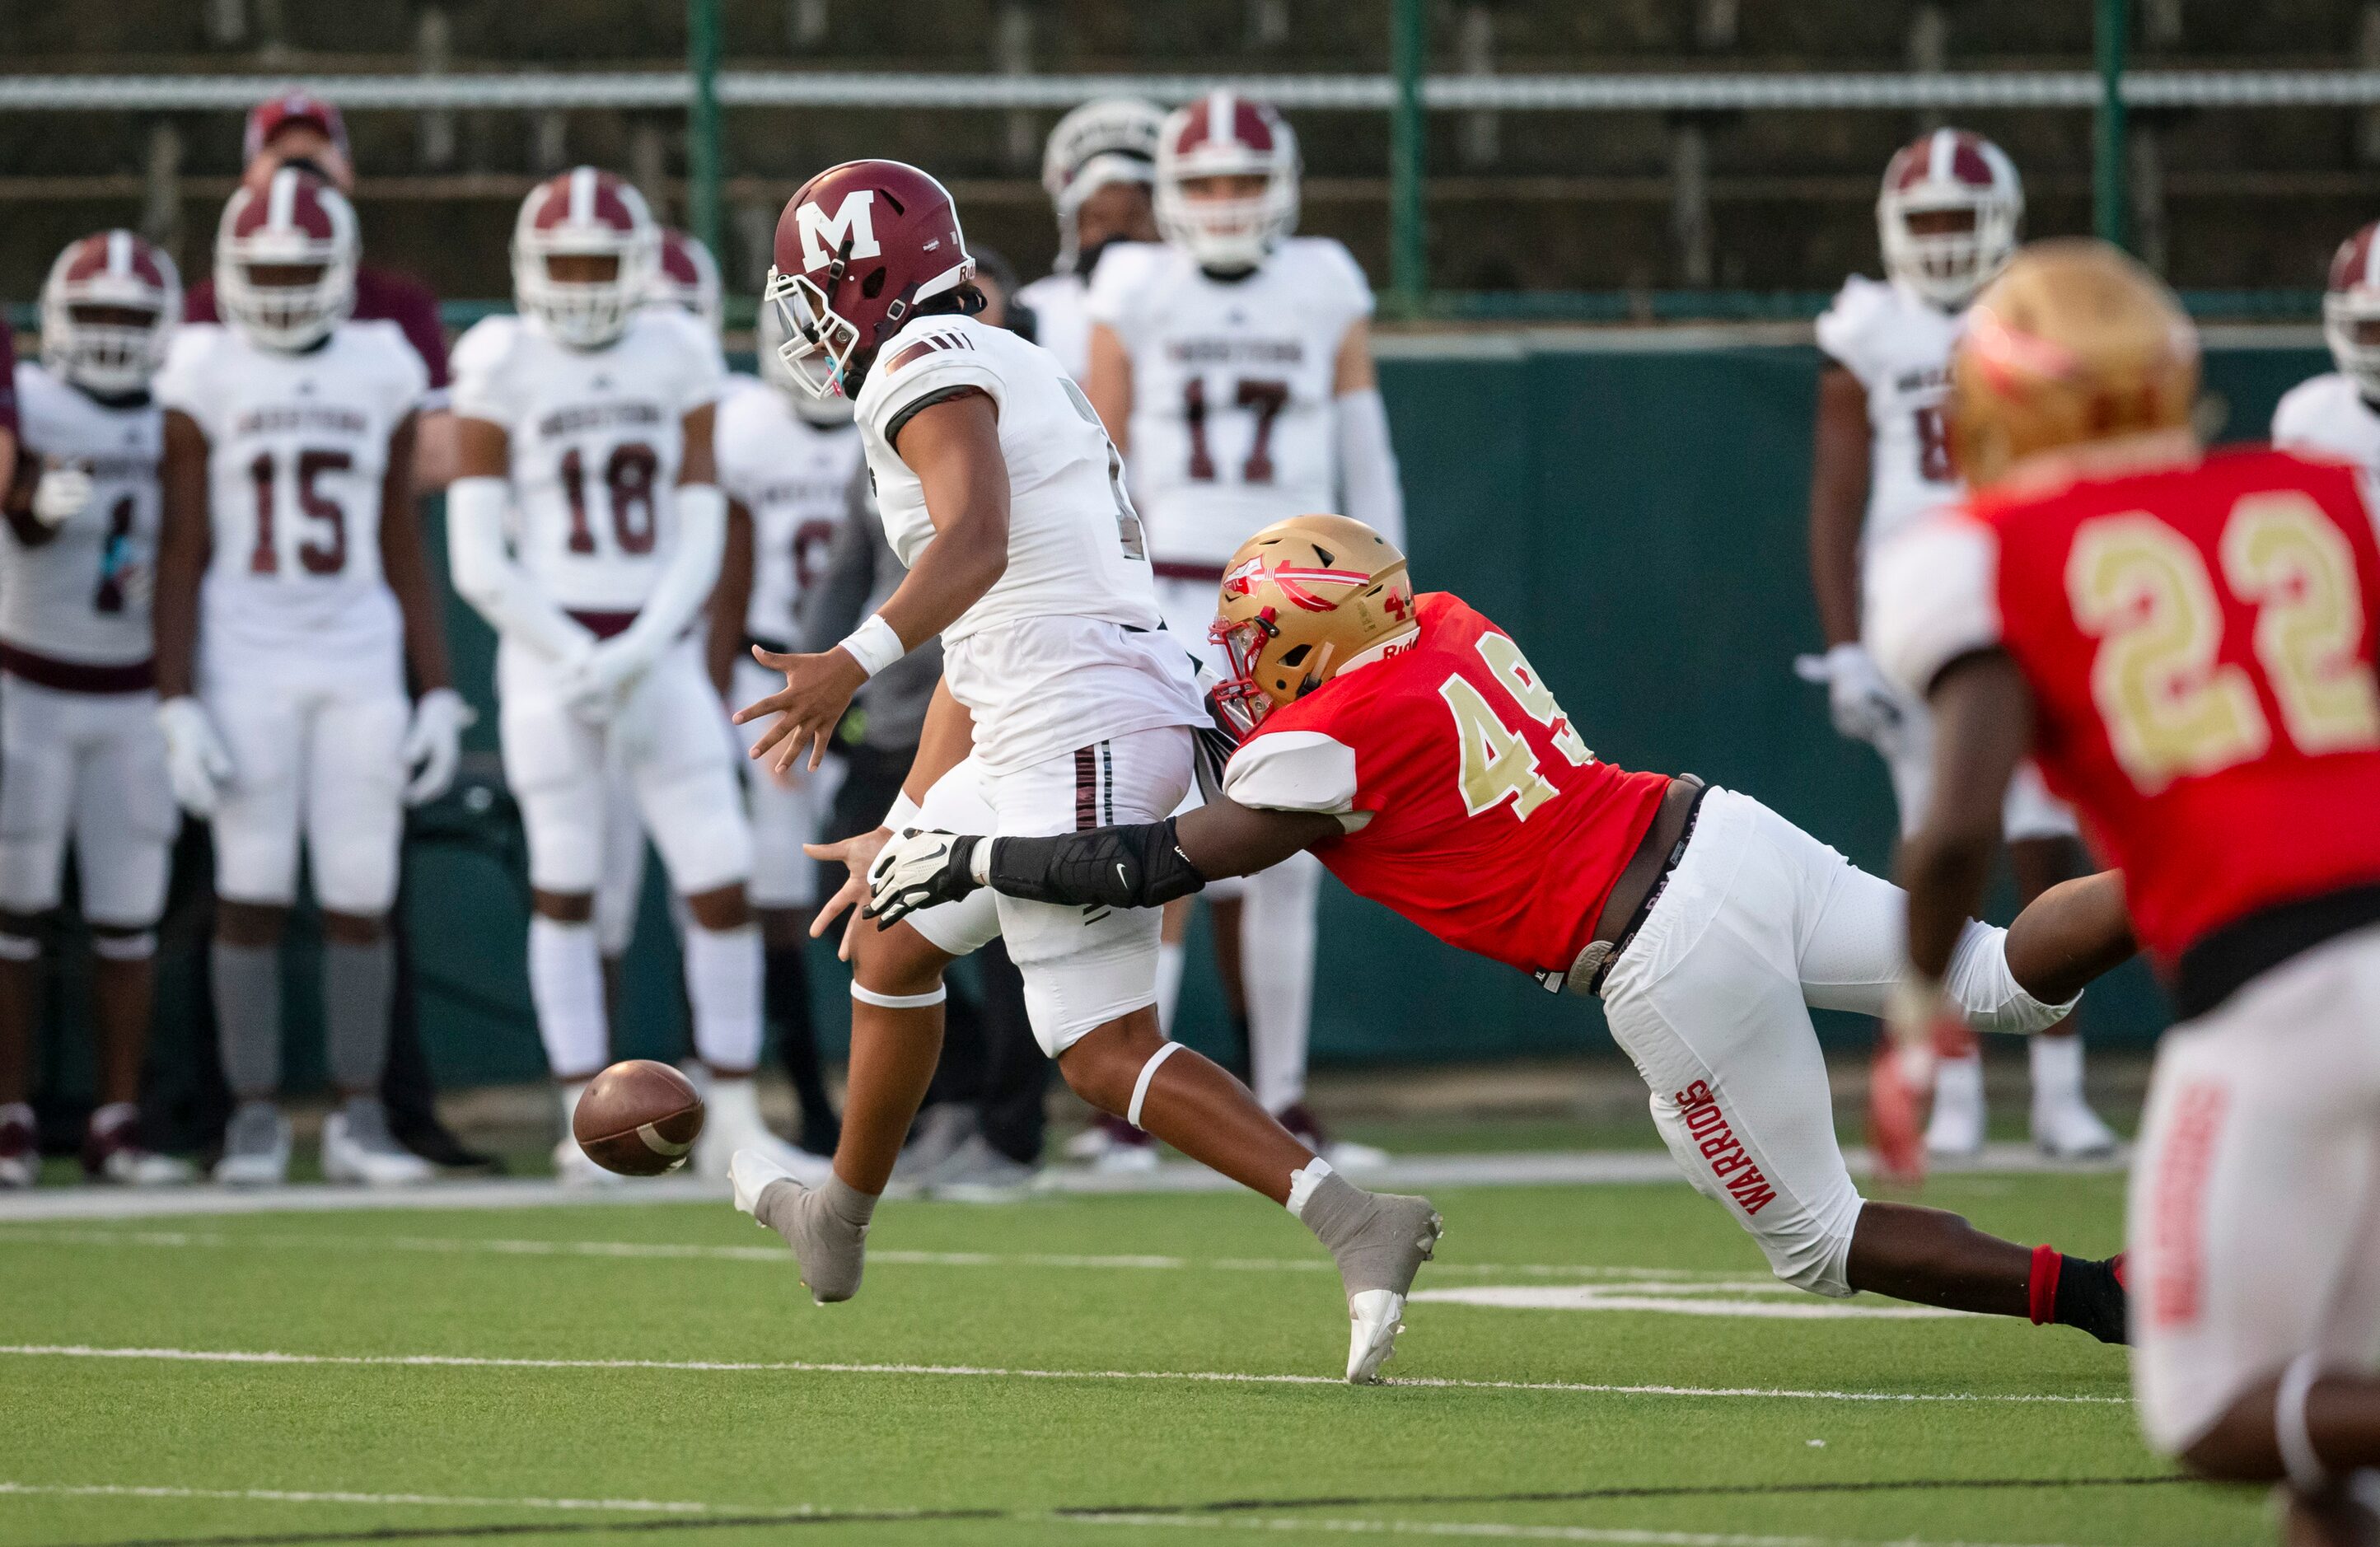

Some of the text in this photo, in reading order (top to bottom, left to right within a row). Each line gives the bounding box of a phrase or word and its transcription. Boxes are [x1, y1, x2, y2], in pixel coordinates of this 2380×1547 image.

[796, 190, 881, 273] M
[1185, 377, 1290, 480] 17
[250, 451, 350, 574] 15
[561, 443, 657, 554] 18
[2064, 490, 2380, 797] 22
[1438, 631, 1596, 823] 49
